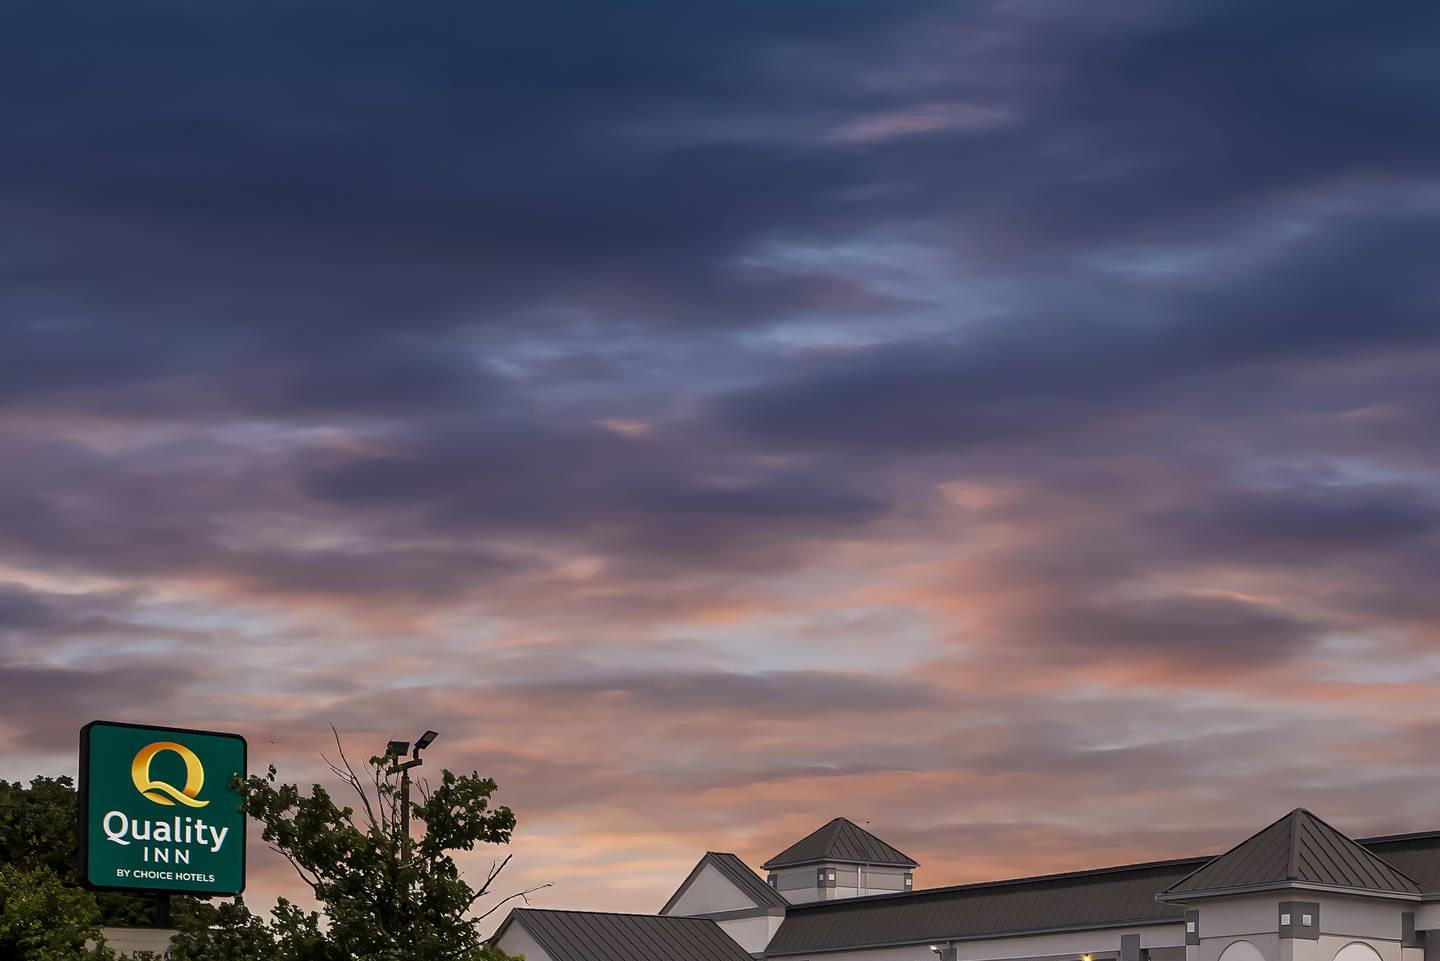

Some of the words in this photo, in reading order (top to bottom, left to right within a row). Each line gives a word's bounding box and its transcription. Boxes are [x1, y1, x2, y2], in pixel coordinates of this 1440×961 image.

[131, 741, 210, 808] Q
[103, 810, 229, 853] Quality
[143, 847, 190, 864] INN
[116, 869, 131, 877] BY
[133, 870, 173, 880] CHOICE
[175, 873, 215, 882] HOTELS
